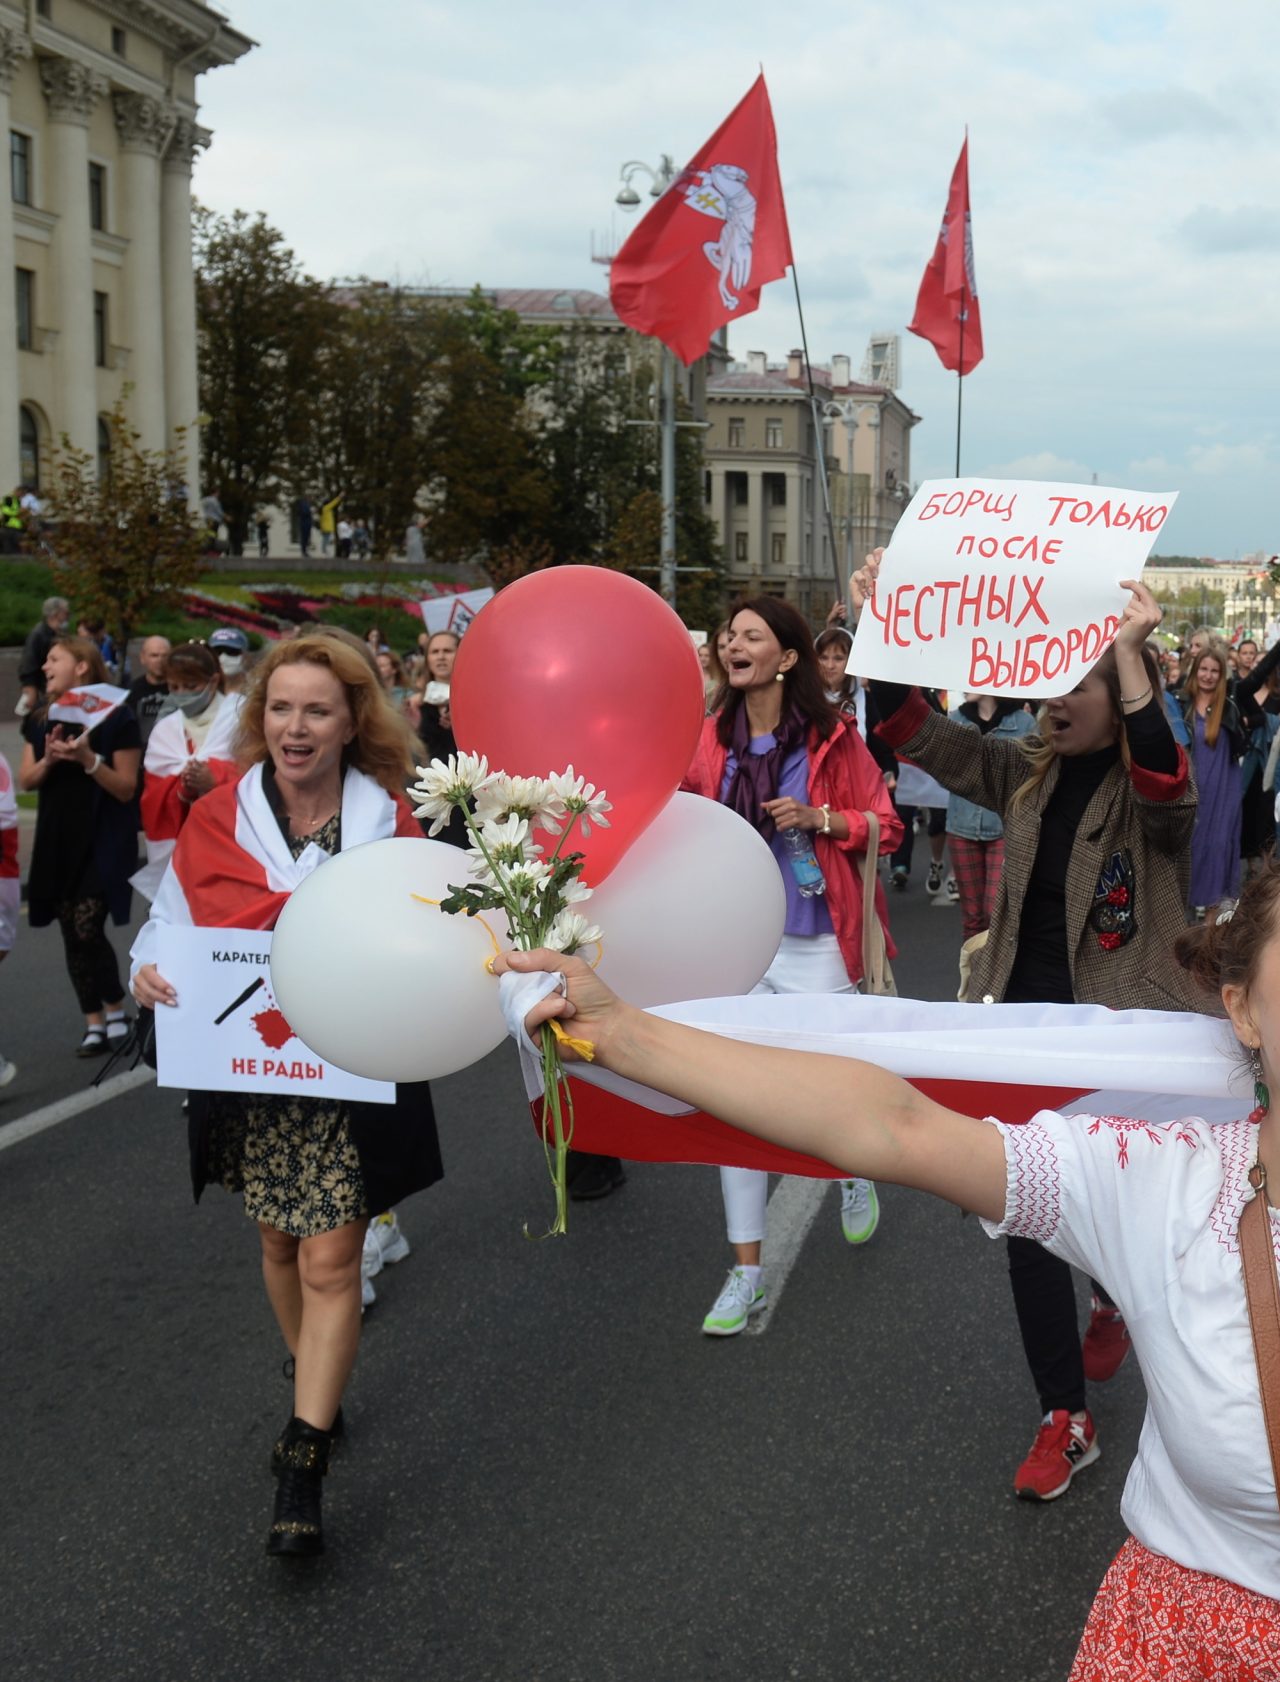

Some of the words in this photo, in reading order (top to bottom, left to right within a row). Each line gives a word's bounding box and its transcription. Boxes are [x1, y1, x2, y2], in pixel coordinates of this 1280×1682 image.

[917, 489, 1018, 522] БОРЩ
[1048, 496, 1169, 533] ТОЛЬКО
[955, 535, 1064, 565] ПОСЛЕ
[870, 574, 1050, 648] ЧЕСТНЫХ
[967, 615, 1120, 689] ВЫБОРОВ
[212, 951, 271, 965] КАРАТЕЛ
[231, 1057, 257, 1075] НЕ
[262, 1060, 323, 1080] РАДЫ
